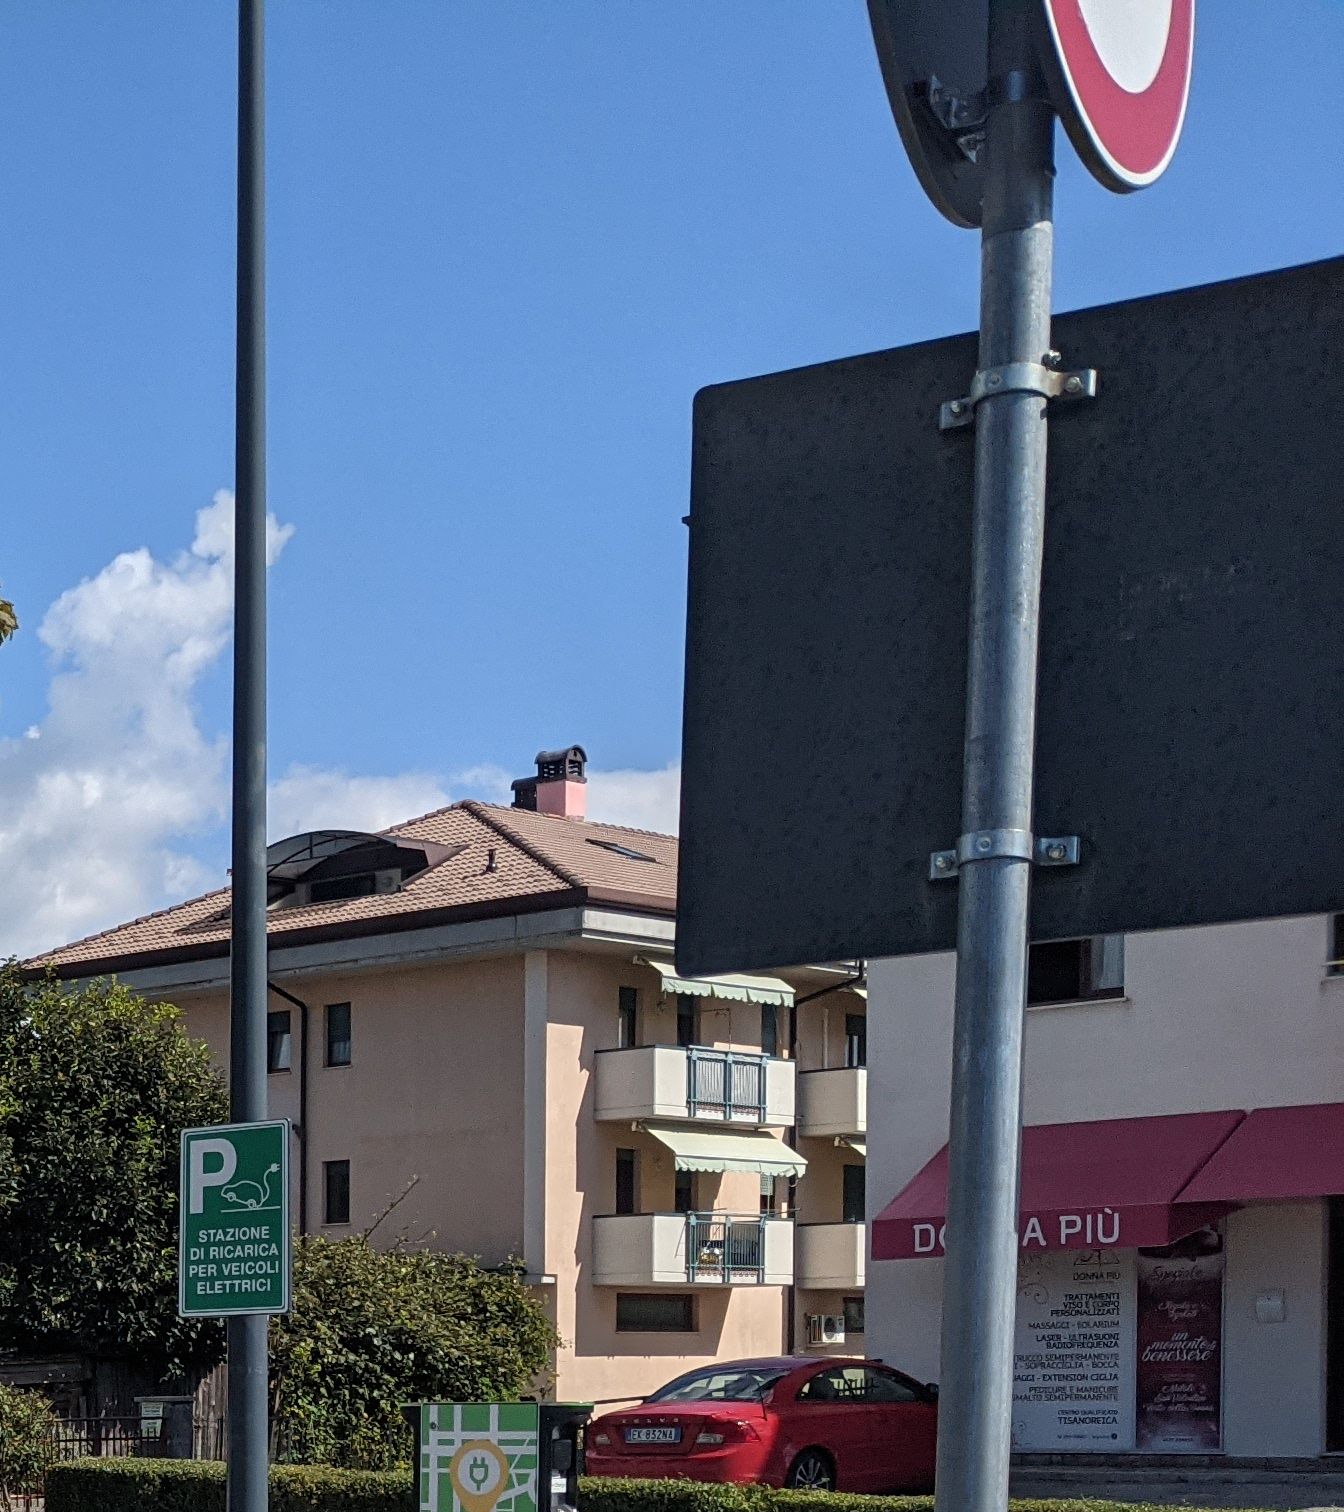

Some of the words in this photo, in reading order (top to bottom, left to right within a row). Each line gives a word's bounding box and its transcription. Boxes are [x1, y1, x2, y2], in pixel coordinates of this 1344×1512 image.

[189, 1138, 237, 1214] P
[198, 1226, 270, 1243] STAZIONE
[1059, 1207, 1120, 1245] PIÙ
[190, 1247, 205, 1260] DI
[209, 1242, 279, 1259] RICARICA
[189, 1264, 217, 1277] PER
[221, 1260, 279, 1276] VEICOLI
[197, 1278, 271, 1295] ELETTRICI
[1063, 1293, 1120, 1302] TRATTAMENTI
[1050, 1308, 1120, 1316] PERSONALIZZATI
[1057, 1416, 1119, 1424] TISANOREICA
